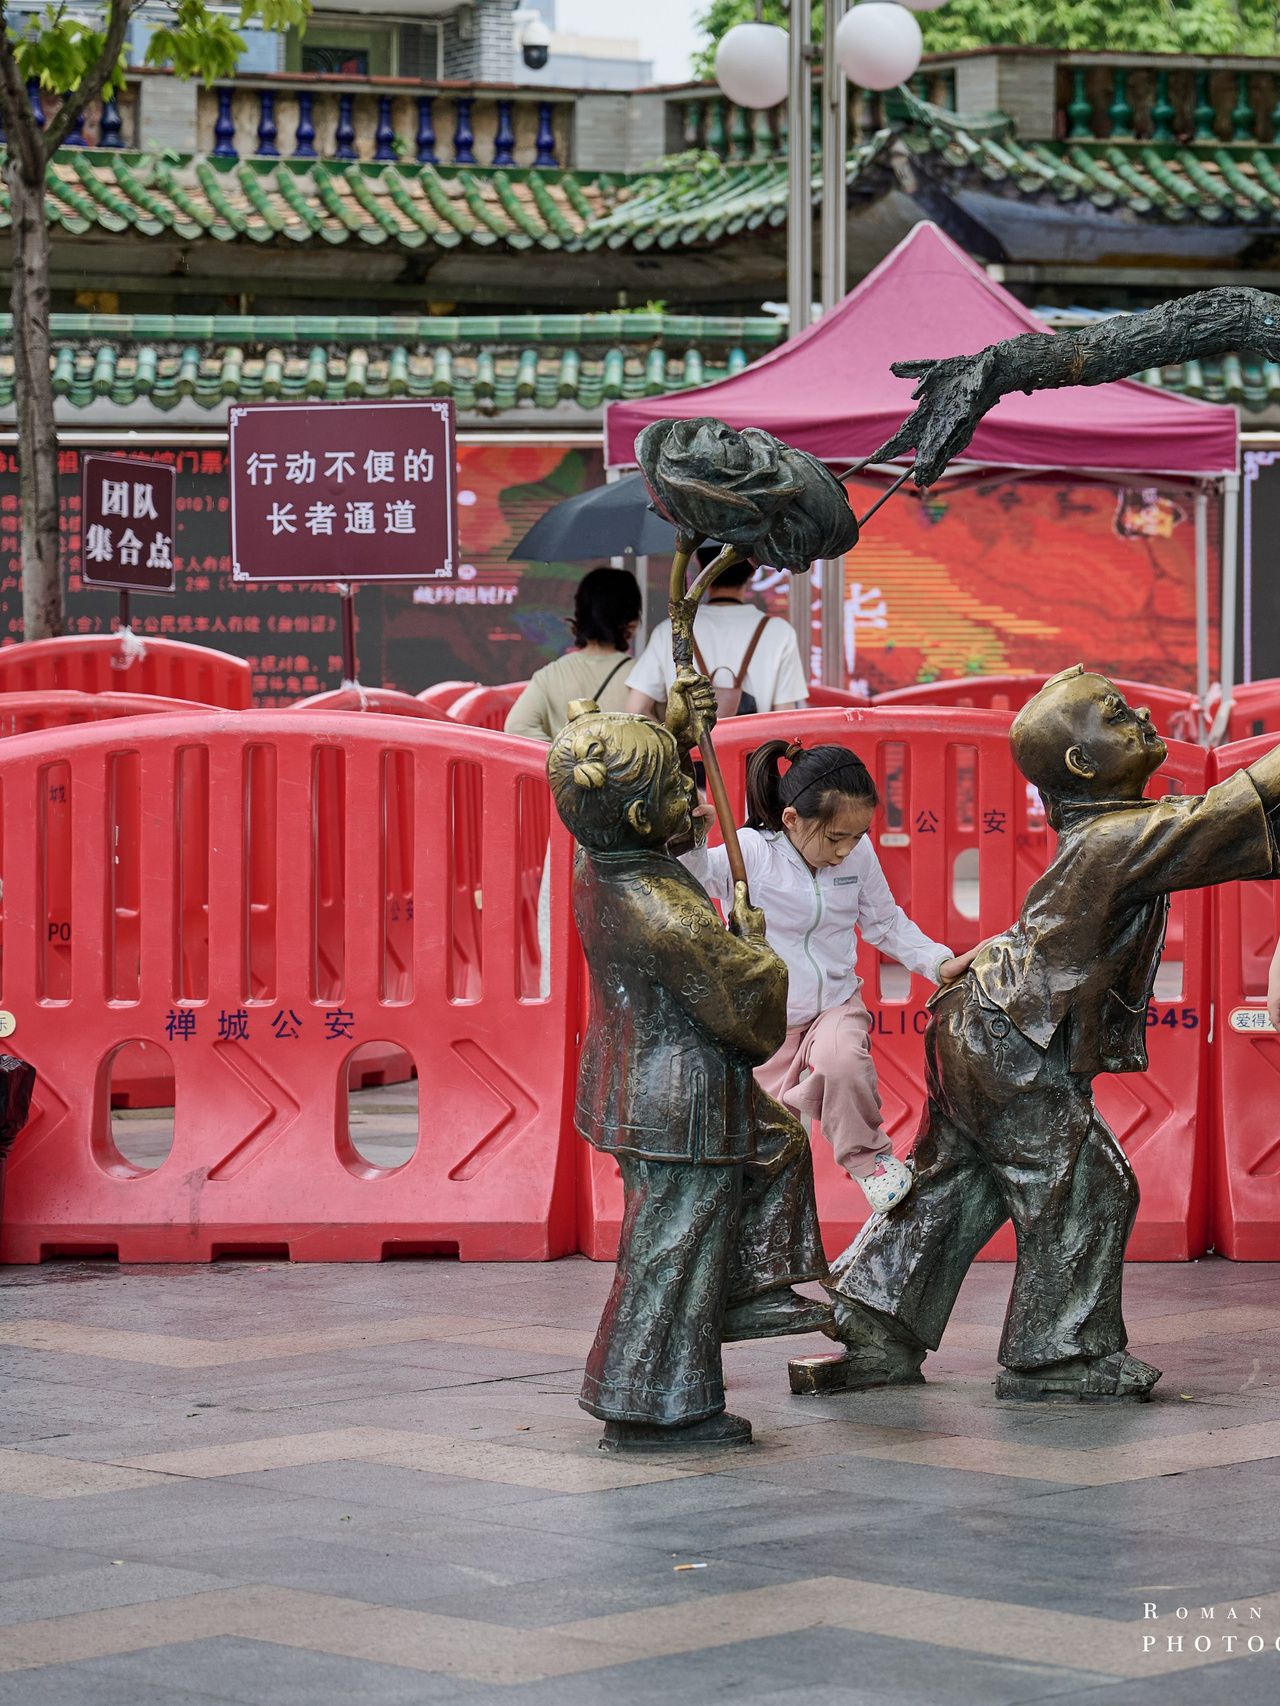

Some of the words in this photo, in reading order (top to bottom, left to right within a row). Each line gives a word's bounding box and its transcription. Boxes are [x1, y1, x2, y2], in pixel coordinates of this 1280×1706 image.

[246, 448, 434, 486] 行动不便的
[102, 478, 158, 520] 团队
[266, 500, 416, 536] 长者通道
[86, 523, 173, 570] 集合点
[165, 1008, 355, 1041] 禅城公安
[1146, 1006, 1198, 1029] 645
[1236, 1012, 1276, 1029] 爱得
